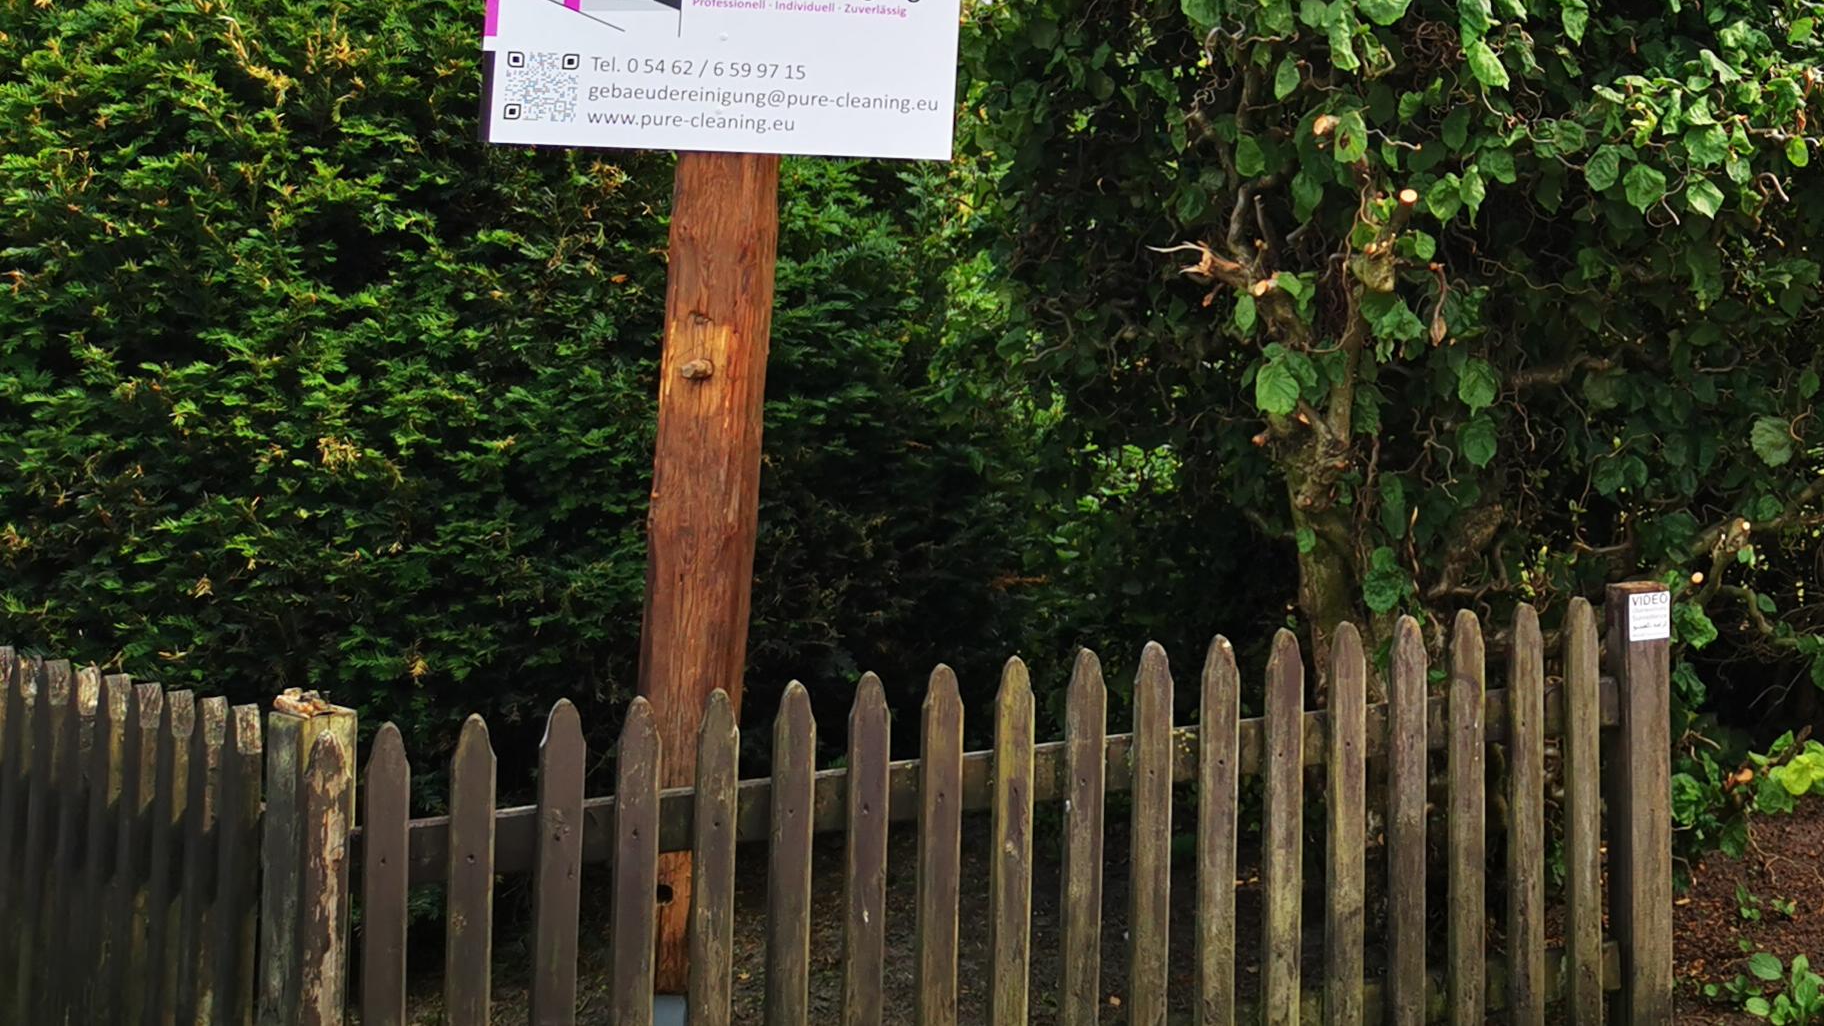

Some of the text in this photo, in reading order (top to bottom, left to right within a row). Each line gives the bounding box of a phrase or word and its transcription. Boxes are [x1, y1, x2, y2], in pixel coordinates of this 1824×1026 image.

[775, 0, 835, 13] Individuell
[844, 4, 907, 18] Zuverlässig
[591, 57, 620, 73] Tel.
[627, 58, 638, 74] 0
[644, 59, 665, 75] 54
[671, 60, 693, 76] 62
[713, 61, 724, 78] 6
[729, 62, 752, 78] 59
[757, 63, 779, 79] 97
[785, 64, 807, 80] 15
[588, 83, 939, 114] gebaeudereinigung@pure-cleaning.eu
[587, 110, 795, 134] www.pure-cleaning.eu
[1632, 593, 1668, 605] VIDEO
